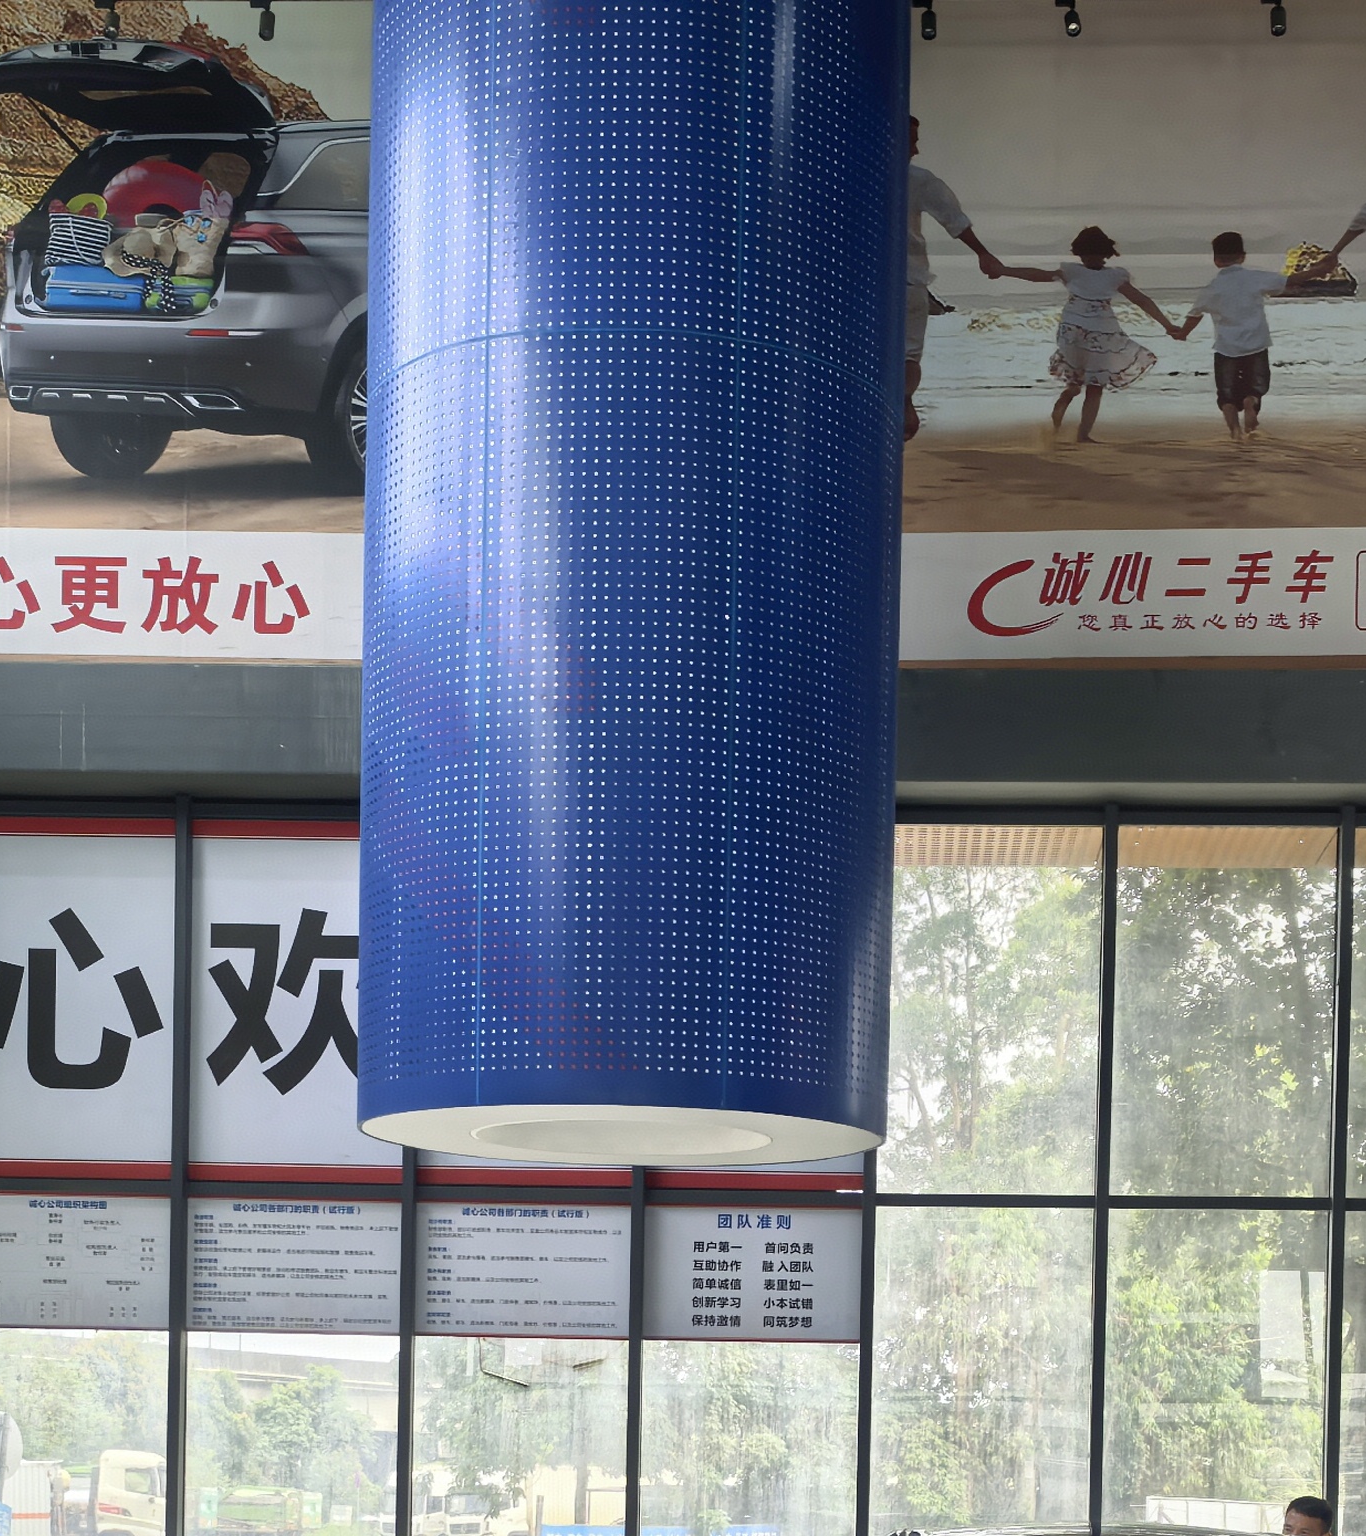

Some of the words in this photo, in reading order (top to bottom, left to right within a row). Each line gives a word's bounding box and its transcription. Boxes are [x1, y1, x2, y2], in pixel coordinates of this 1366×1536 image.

[1037, 550, 1334, 605] 诚心二手车
[1076, 611, 1322, 632] 您真正放心的选择
[718, 1214, 791, 1229] 团队准则
[693, 1241, 742, 1253] 用户第一
[764, 1242, 814, 1255] 首问负责
[692, 1260, 742, 1272] 互助协作
[762, 1261, 814, 1273] 融入团队
[692, 1278, 742, 1291] 简单诚信
[763, 1279, 813, 1291] 表里如一
[692, 1296, 741, 1308] 创新学习
[763, 1298, 813, 1310] 小本试错
[691, 1315, 741, 1327] 保持激情
[763, 1316, 813, 1328] 同筑梦想
